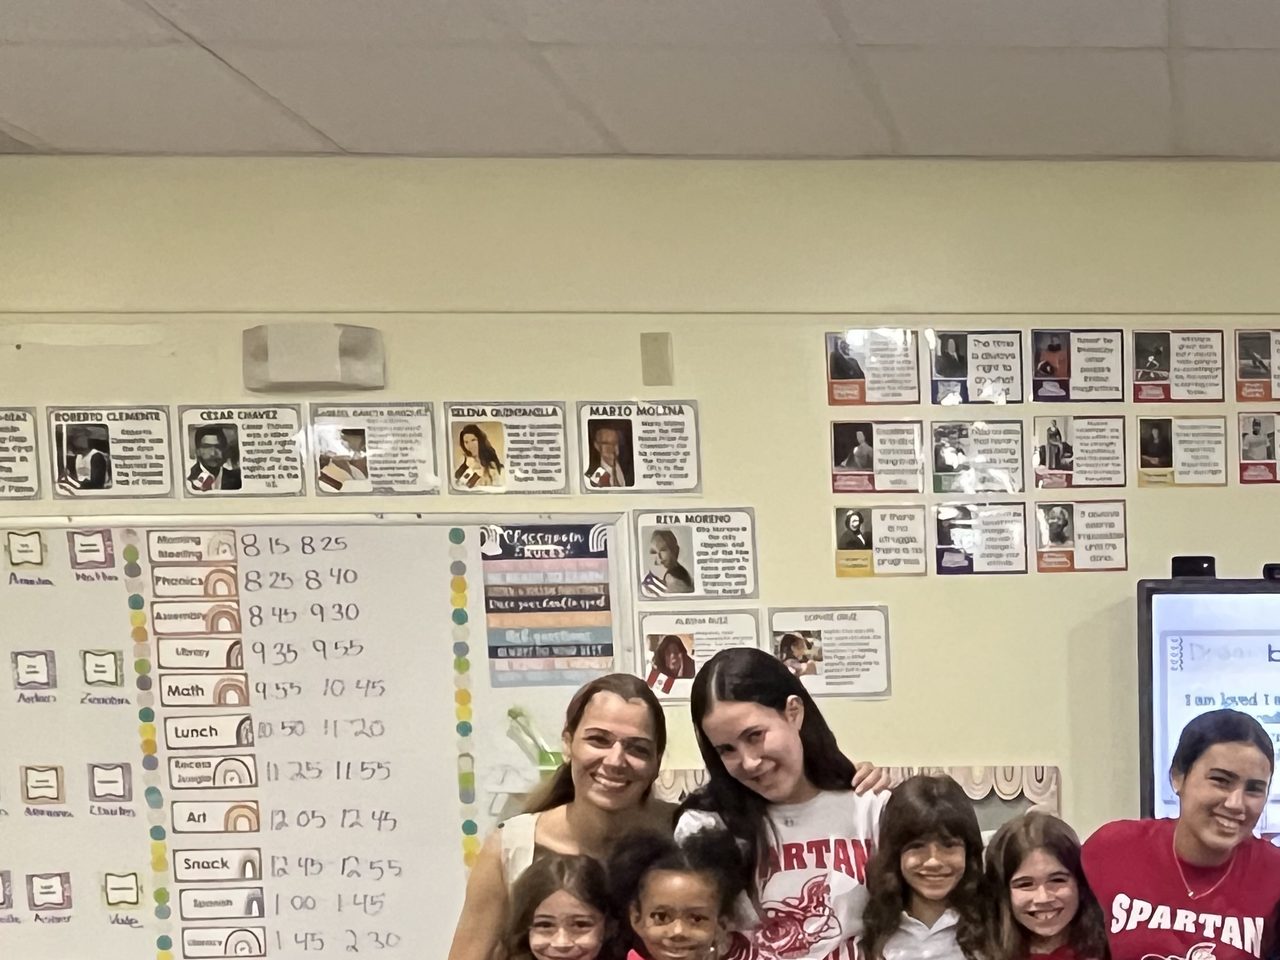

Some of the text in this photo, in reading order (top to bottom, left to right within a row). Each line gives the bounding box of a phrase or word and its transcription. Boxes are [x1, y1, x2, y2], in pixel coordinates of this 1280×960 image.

[590, 404, 684, 416] MARIO MOLINA
[656, 514, 732, 524] RITA MORENO
[524, 549, 566, 559] RULES
[168, 684, 204, 697] Math
[1194, 696, 1216, 706] am
[174, 726, 218, 739] Lunch
[186, 812, 208, 824] Art
[184, 858, 230, 870] Snack
[1109, 892, 1265, 959] SPARTAN
